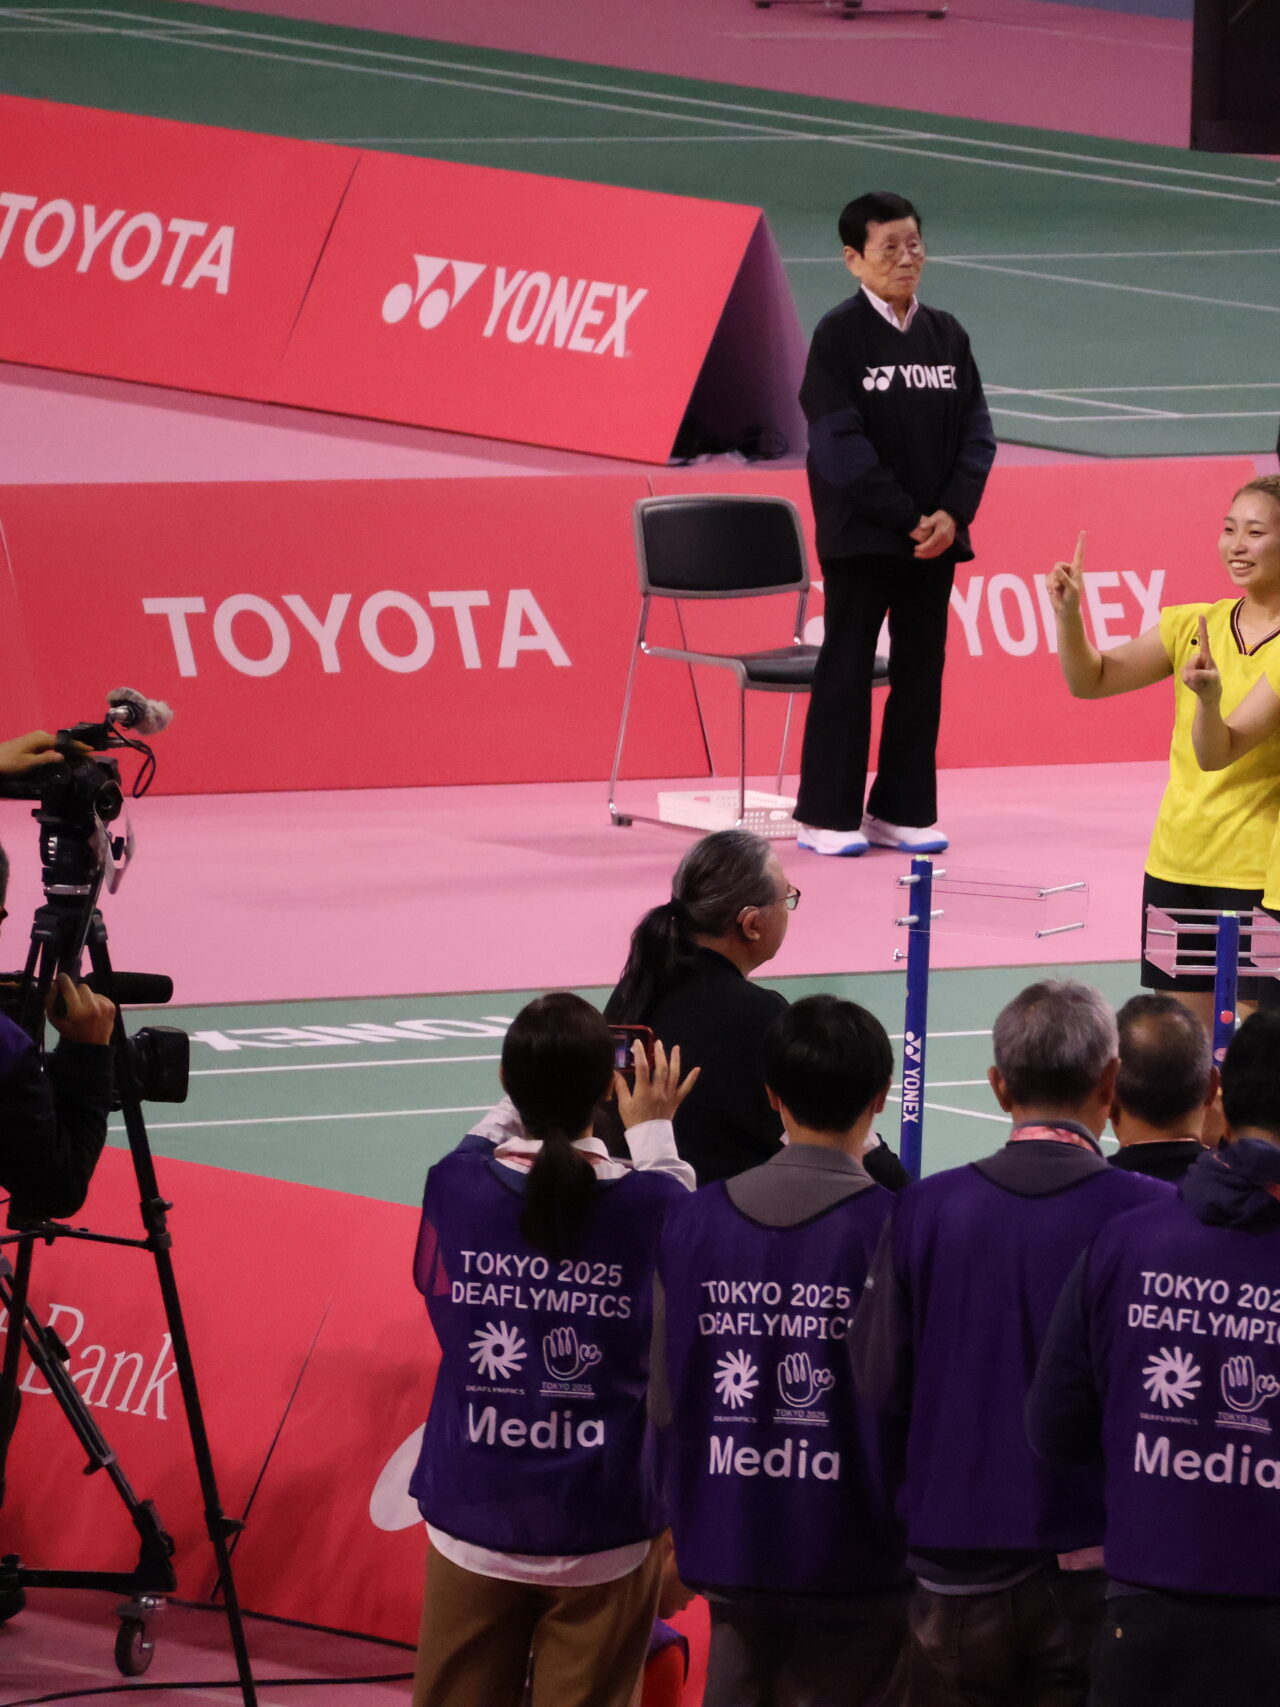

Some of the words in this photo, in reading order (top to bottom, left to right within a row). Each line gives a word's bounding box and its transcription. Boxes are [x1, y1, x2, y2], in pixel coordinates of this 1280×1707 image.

[0, 192, 235, 294] TOYOTA
[482, 266, 649, 358] YONEX
[142, 589, 571, 677] TOYOTA
[189, 1015, 516, 1051] ONEX
[902, 1068, 921, 1123] YONEX
[460, 1250, 549, 1280] TOKYO
[557, 1259, 622, 1287] 2025
[1140, 1271, 1230, 1304] TOKYO
[451, 1281, 631, 1319] DEAFLYMPICS
[700, 1280, 782, 1305] TOKYO
[790, 1283, 851, 1309] 2025
[699, 1311, 853, 1340] DAFLYMPIC
[467, 1402, 605, 1450] Media
[709, 1435, 840, 1481] Media
